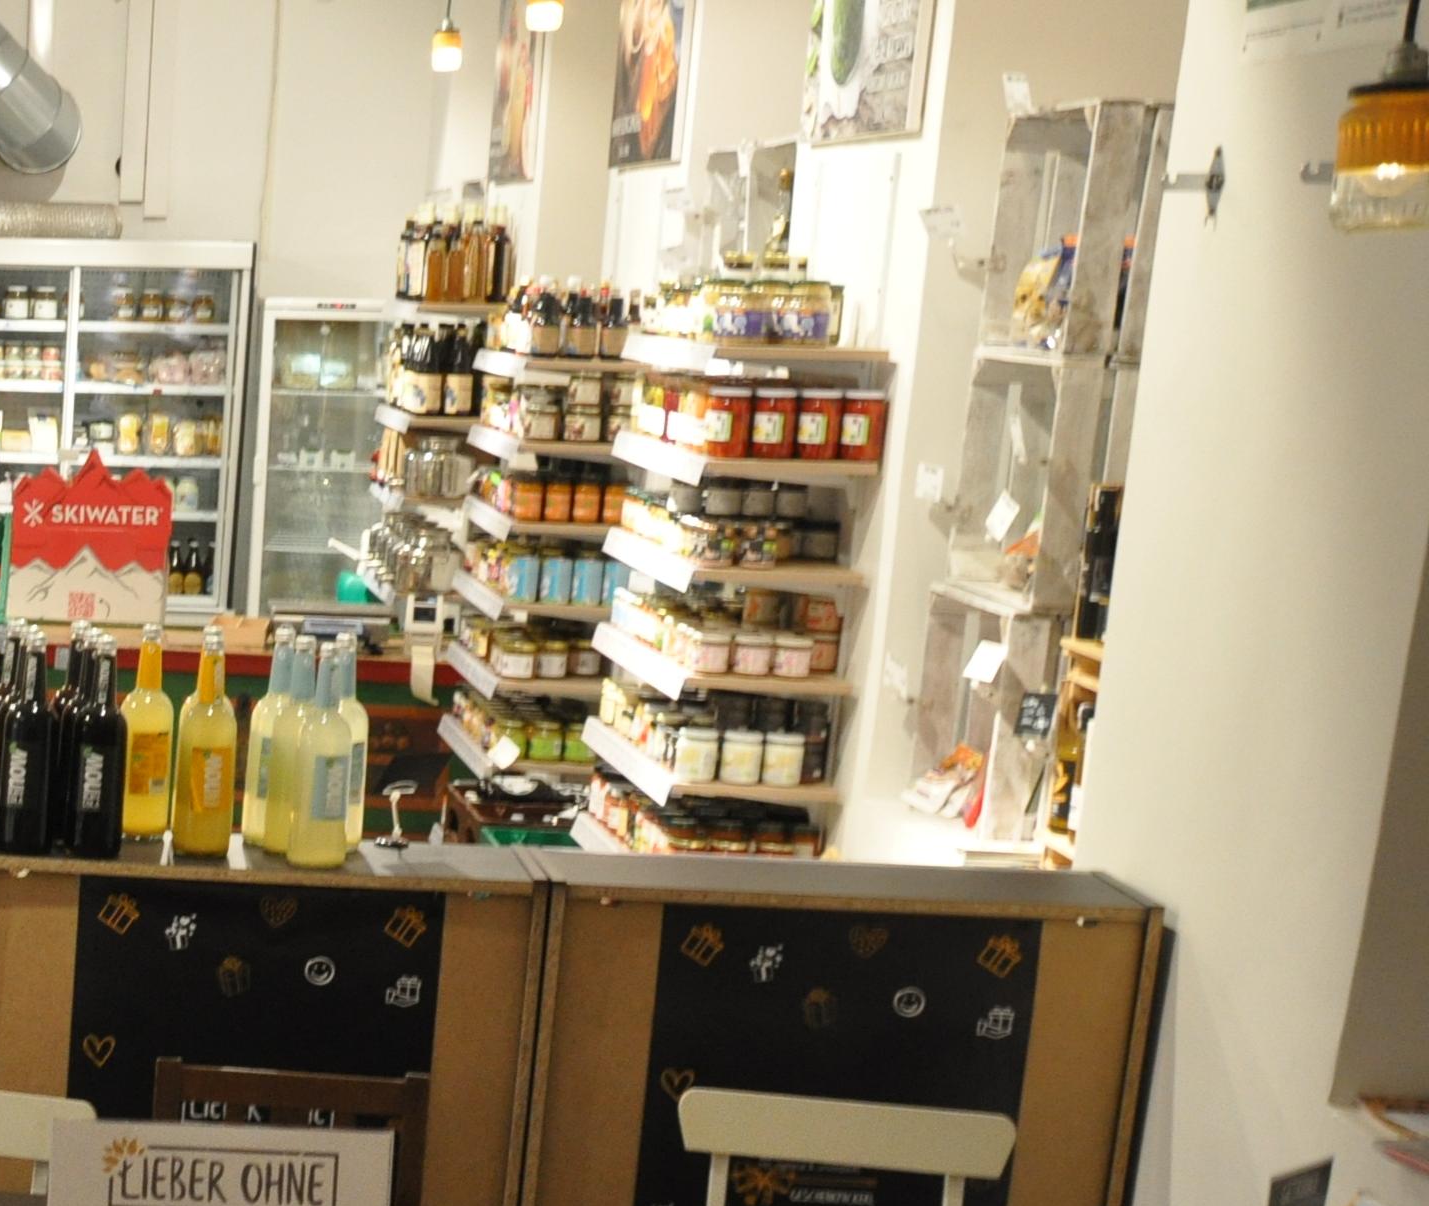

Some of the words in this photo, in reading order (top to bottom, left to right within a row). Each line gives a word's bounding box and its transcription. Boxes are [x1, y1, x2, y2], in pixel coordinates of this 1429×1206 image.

[51, 504, 160, 526] SKIWATER
[119, 1156, 227, 1204] LIEBER
[241, 1161, 325, 1206] OHNE
